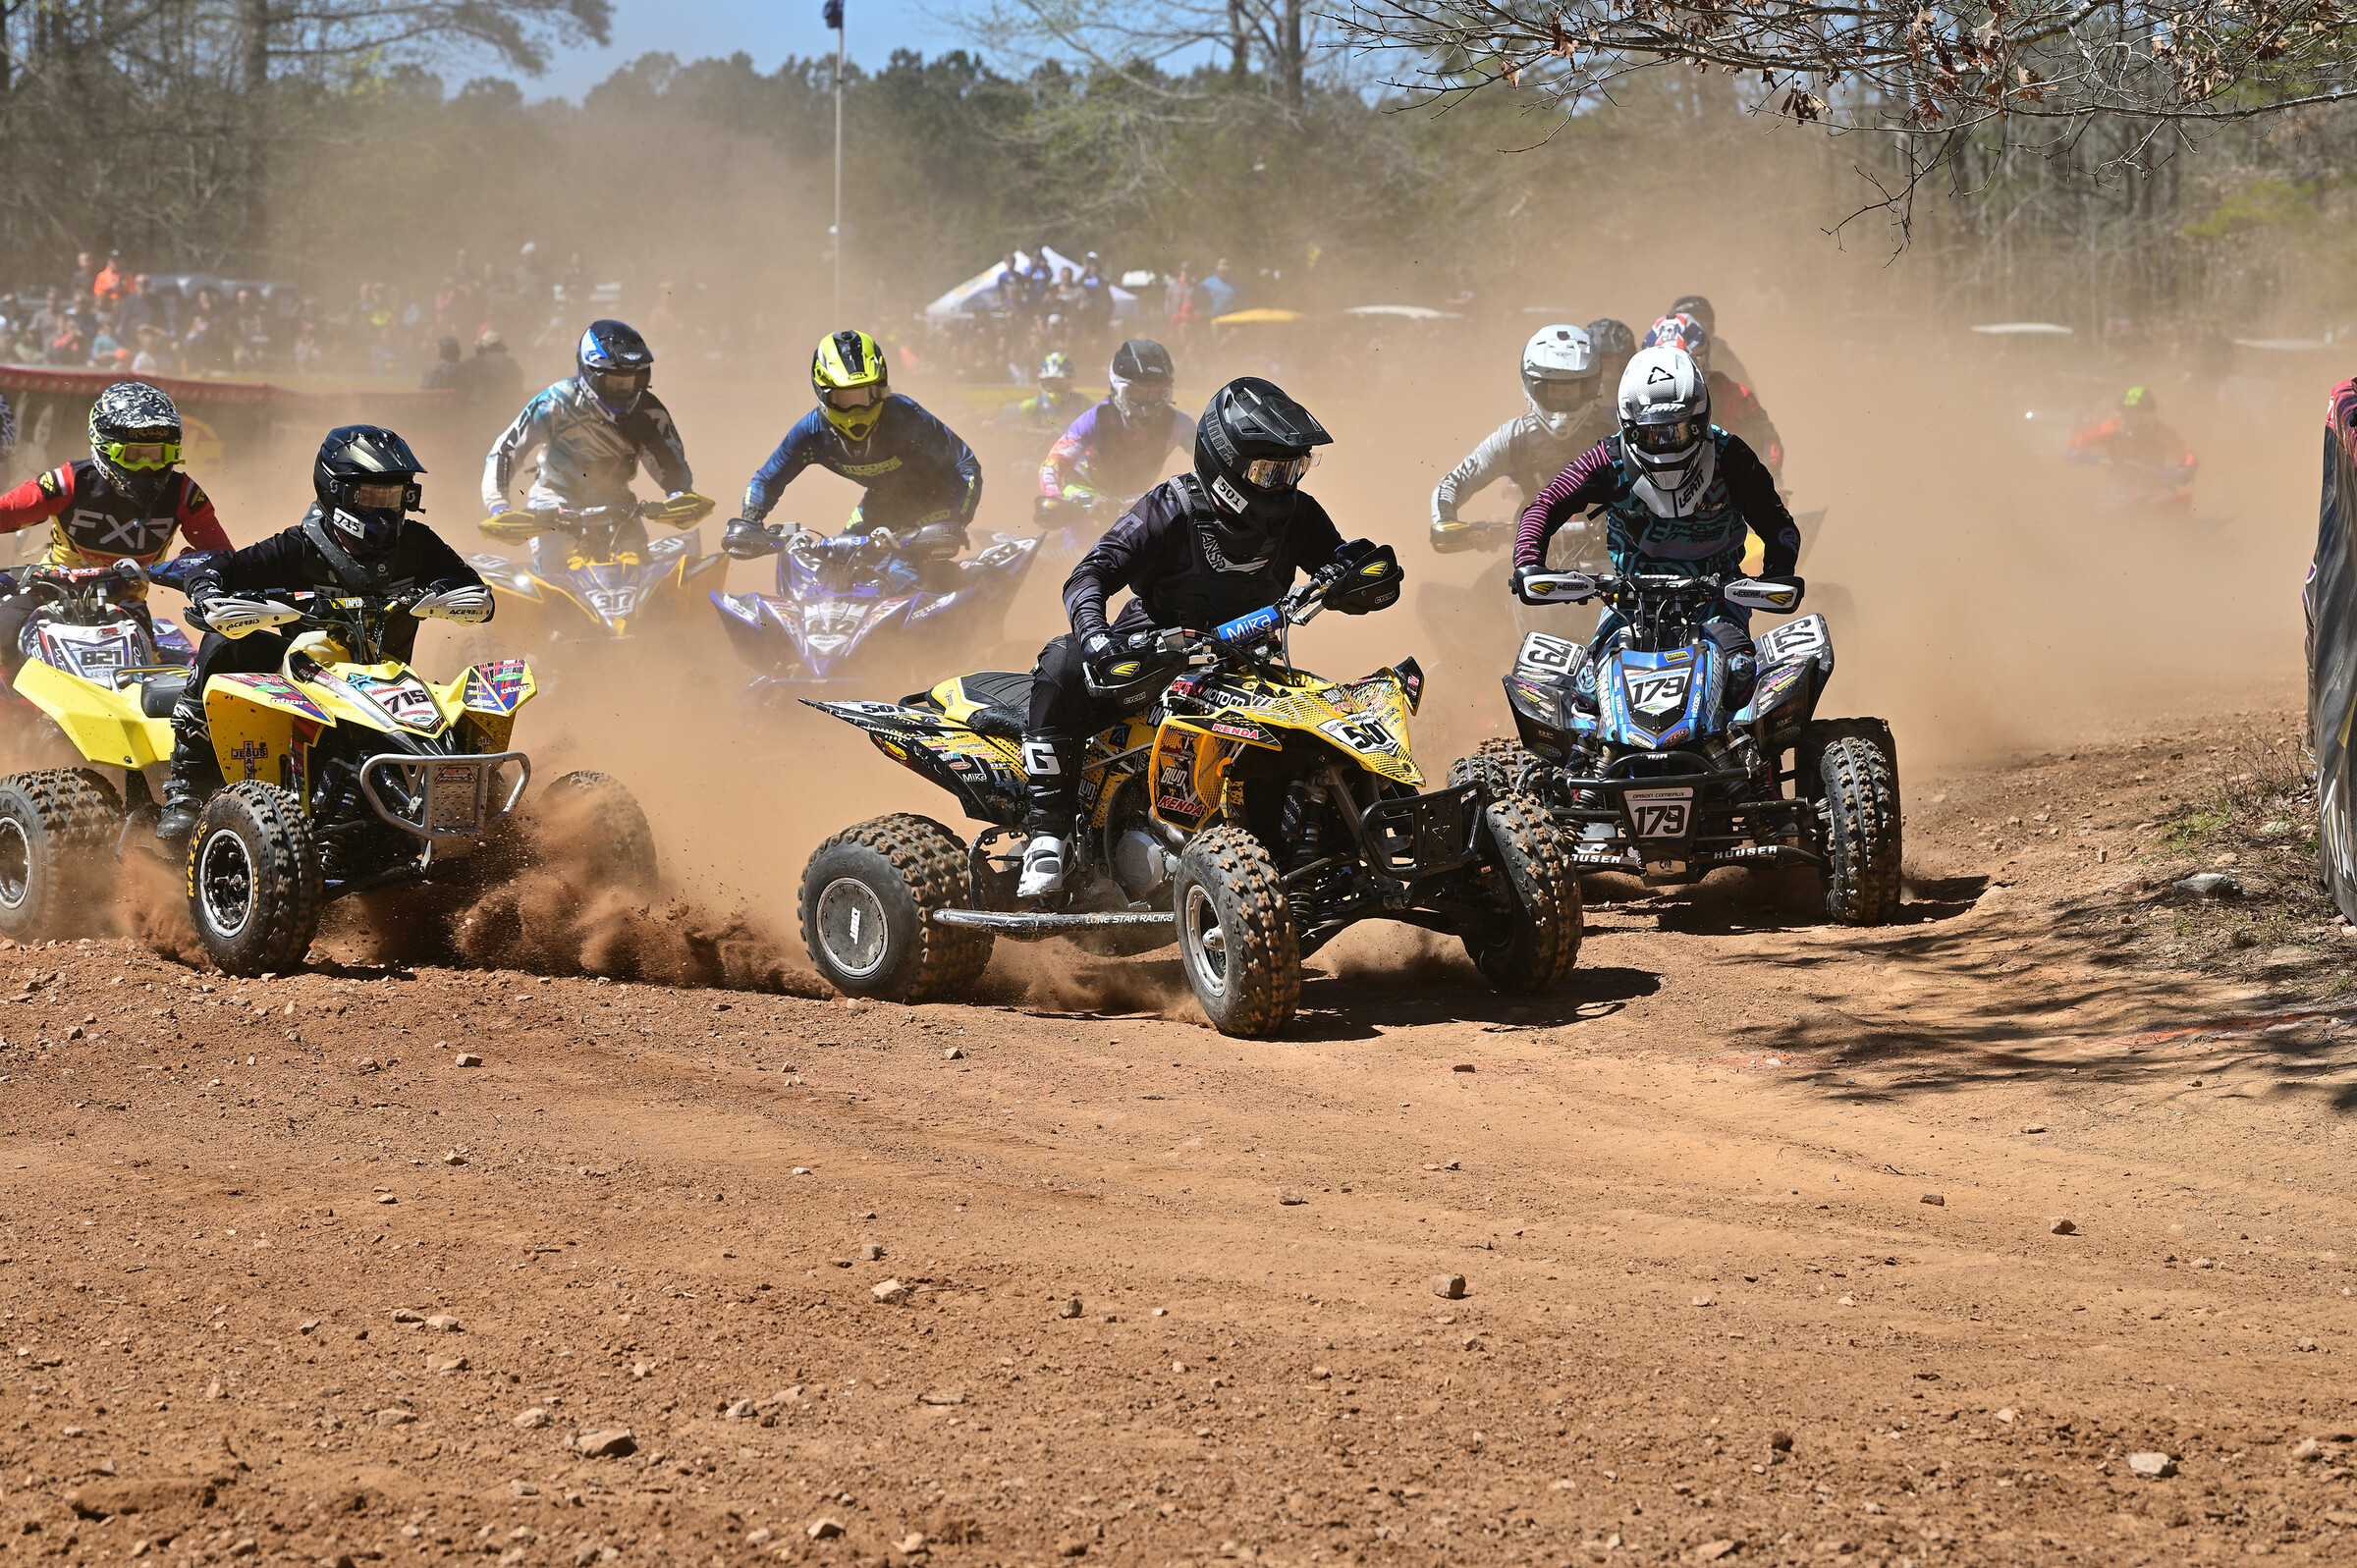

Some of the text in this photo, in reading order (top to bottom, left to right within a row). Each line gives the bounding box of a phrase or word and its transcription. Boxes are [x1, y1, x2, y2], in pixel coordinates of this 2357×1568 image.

[1218, 479, 1240, 507] 501
[1678, 468, 1704, 509] LEATT
[68, 509, 175, 550] FXR
[337, 512, 360, 533] 715
[81, 650, 122, 665] 821
[383, 689, 430, 715] 715
[1631, 676, 1686, 705] 179
[1212, 724, 1260, 740] KENDA
[234, 749, 266, 758] JESUS
[1157, 794, 1205, 818] KENDA
[1634, 805, 1686, 836] 179
[188, 821, 208, 897] MAXXIS
[1714, 845, 1779, 860] HOUSER
[1112, 914, 1137, 924] STAR
[1139, 913, 1175, 923] RACING
